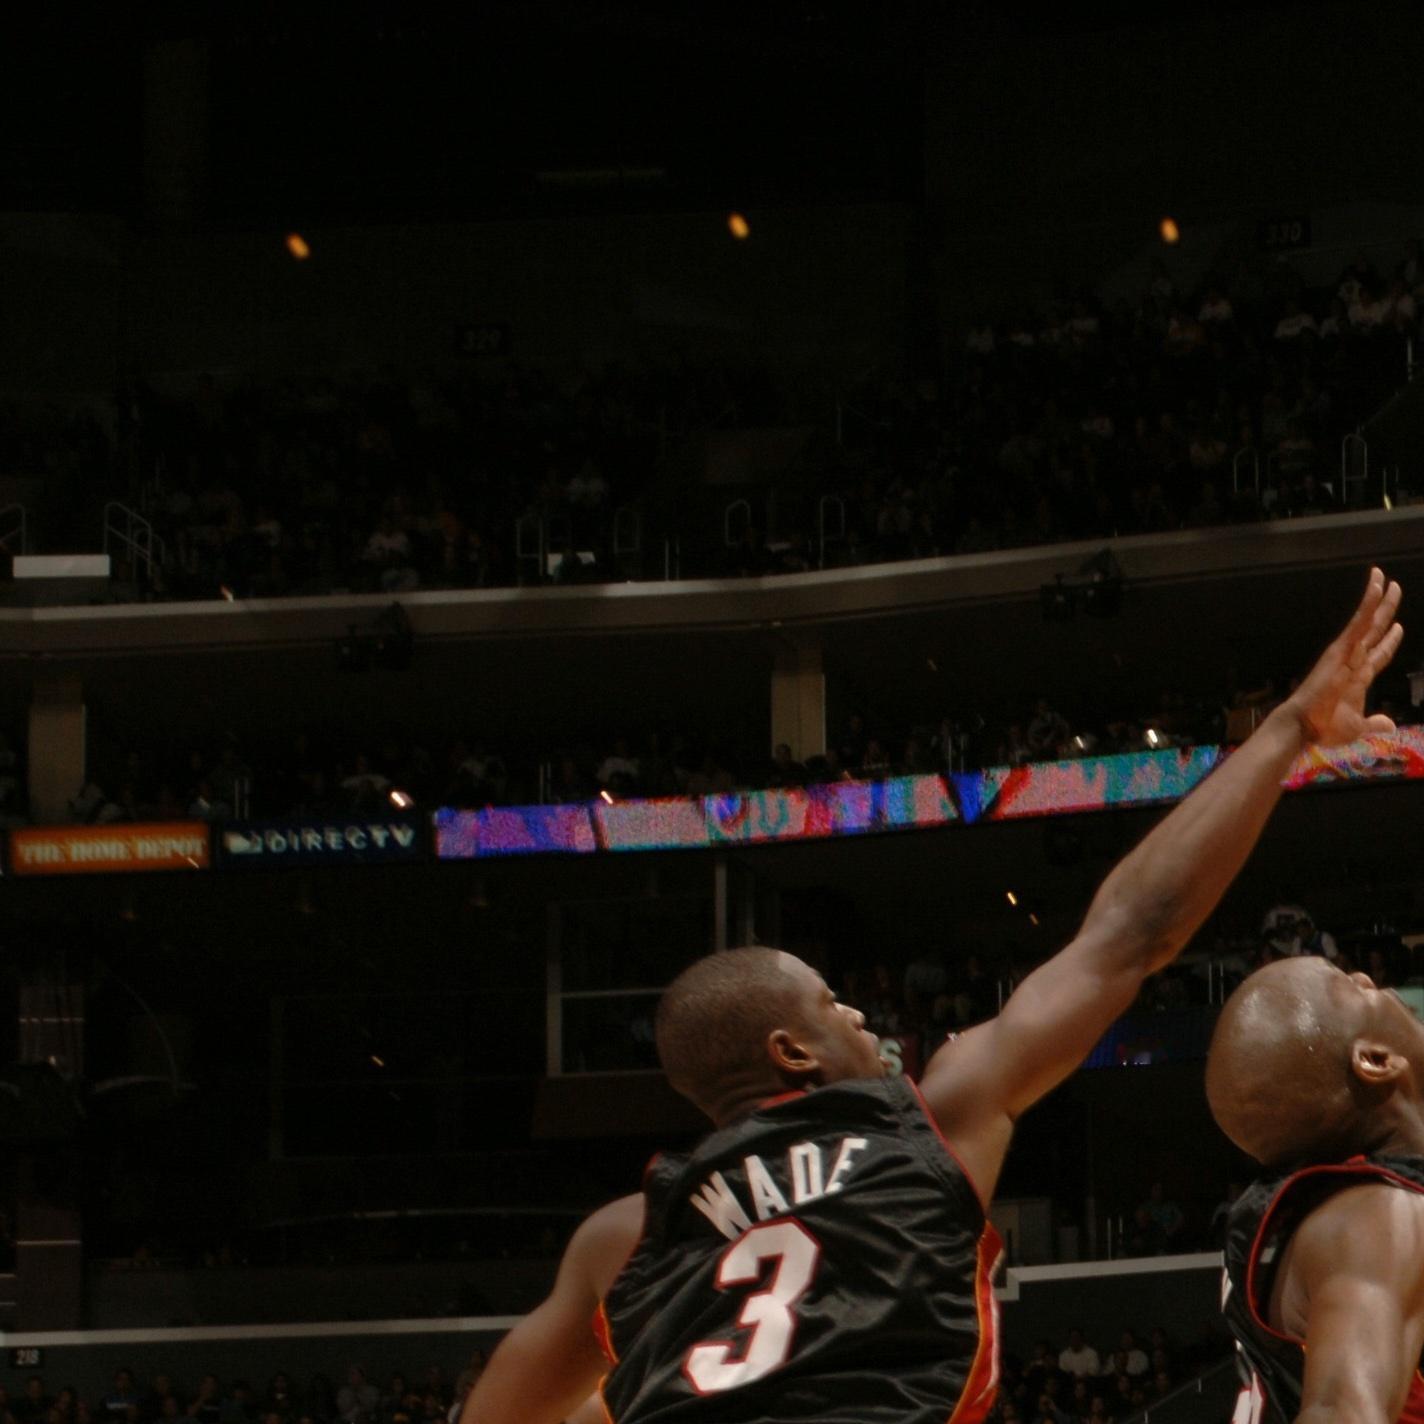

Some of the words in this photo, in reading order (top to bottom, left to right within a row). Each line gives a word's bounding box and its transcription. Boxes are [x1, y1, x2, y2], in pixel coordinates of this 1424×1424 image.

[264, 822, 416, 854] DIRECTV
[689, 1137, 868, 1242] WADE
[680, 1215, 824, 1397] 3
